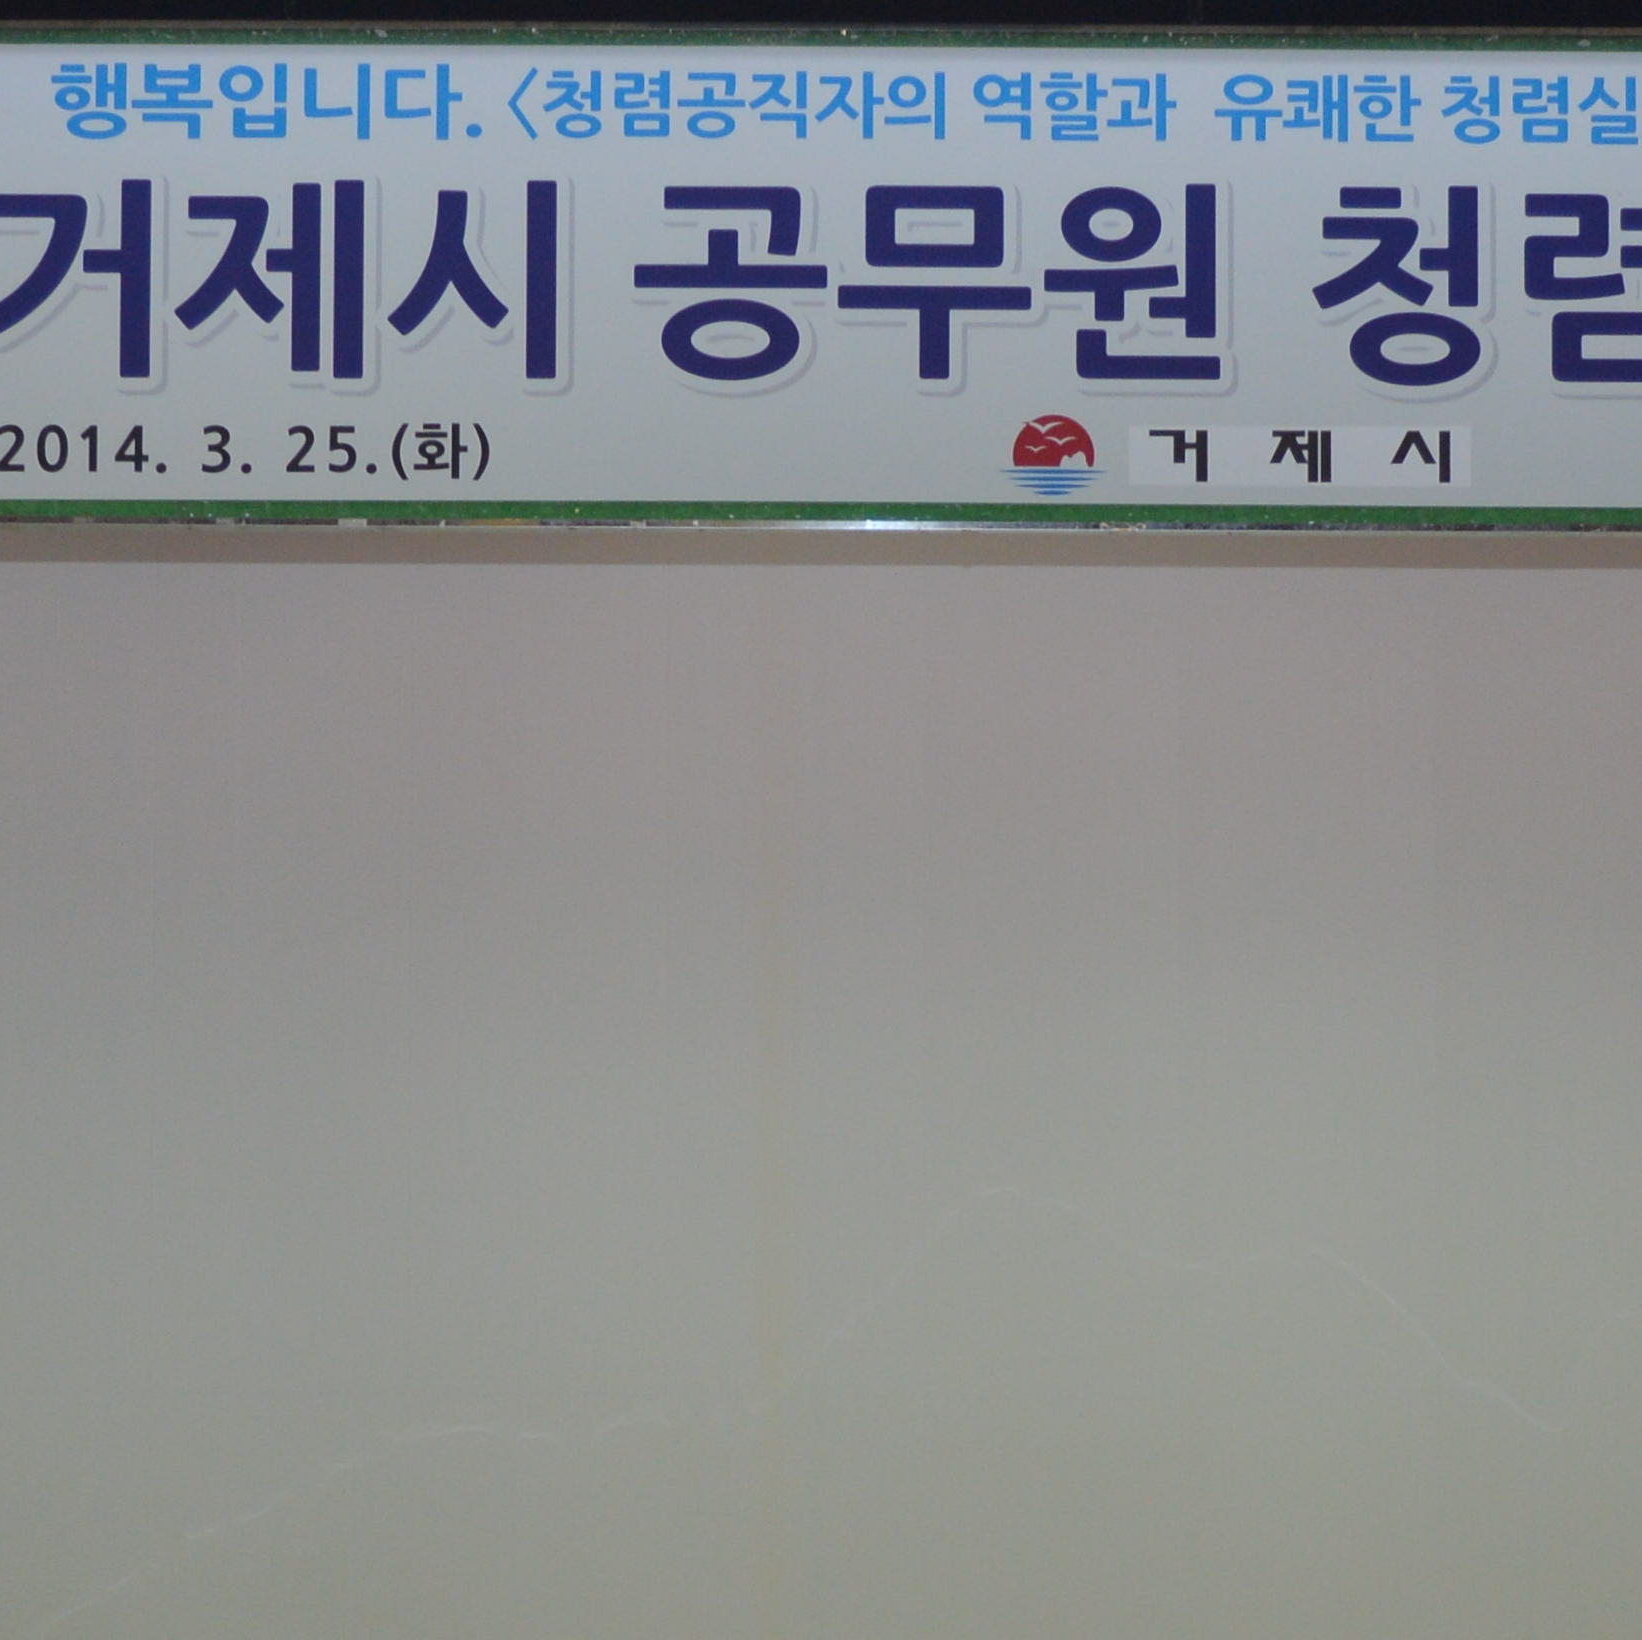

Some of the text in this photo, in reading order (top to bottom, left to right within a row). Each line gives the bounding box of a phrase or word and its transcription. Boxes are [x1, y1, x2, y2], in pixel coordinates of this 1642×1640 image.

[51, 62, 483, 140] 행복입니다.
[973, 72, 1178, 142] 역할과
[1214, 74, 1422, 143] 유쾌한
[635, 184, 1220, 379] 공무원
[203, 426, 251, 473] 3.
[287, 424, 489, 479] 25.(화)
